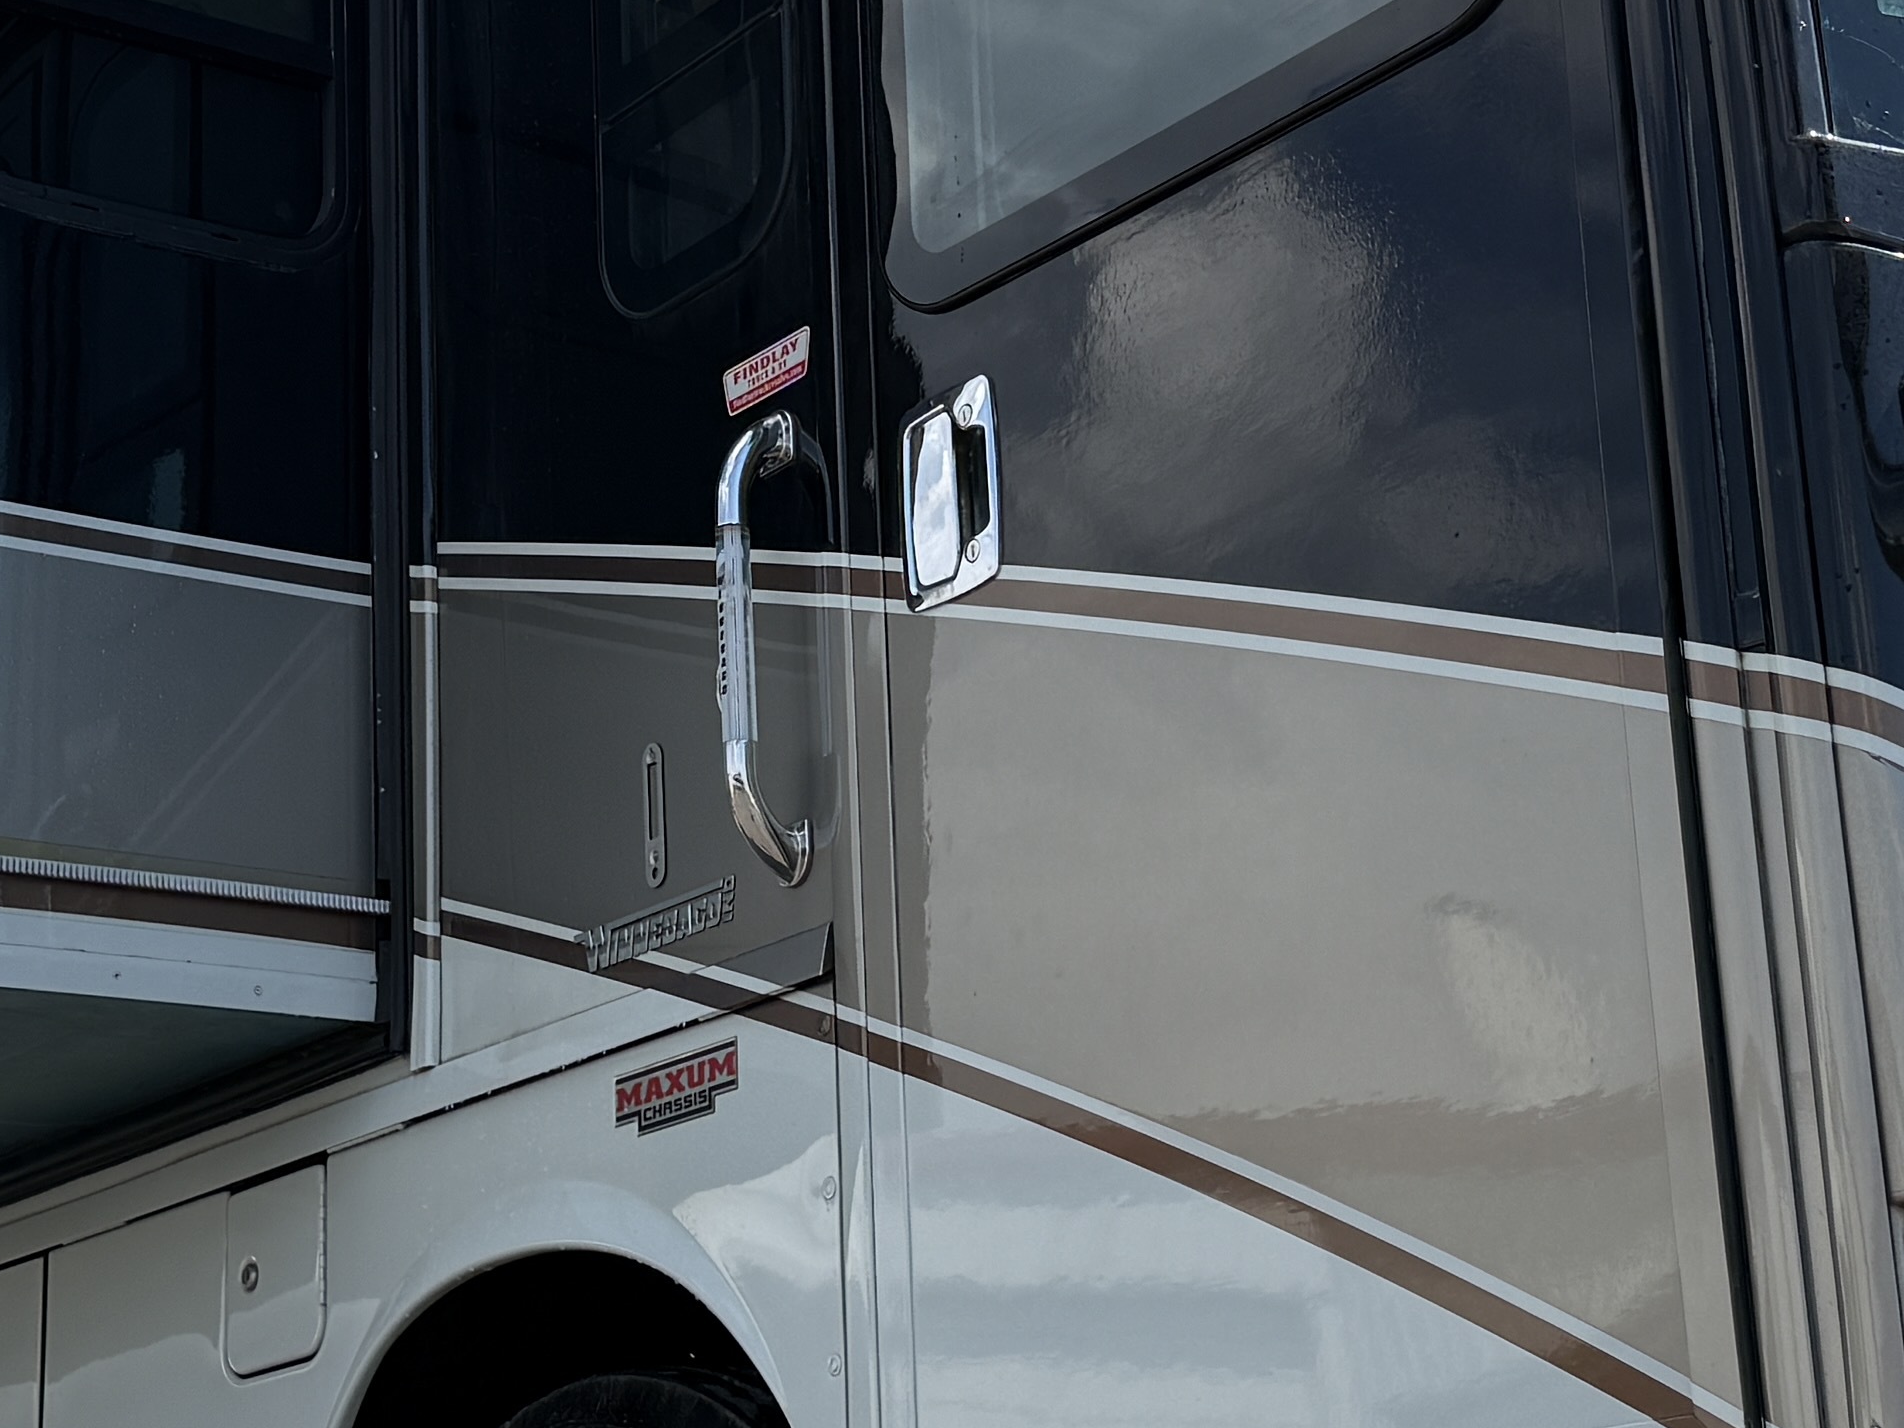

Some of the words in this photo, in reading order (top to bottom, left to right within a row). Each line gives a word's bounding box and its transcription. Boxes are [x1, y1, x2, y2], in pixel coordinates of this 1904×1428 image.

[733, 337, 799, 385] FINDLAY
[576, 888, 724, 974] WINNEBAGO
[616, 1050, 736, 1113] MAXUM
[643, 1089, 707, 1121] CHASSIS
